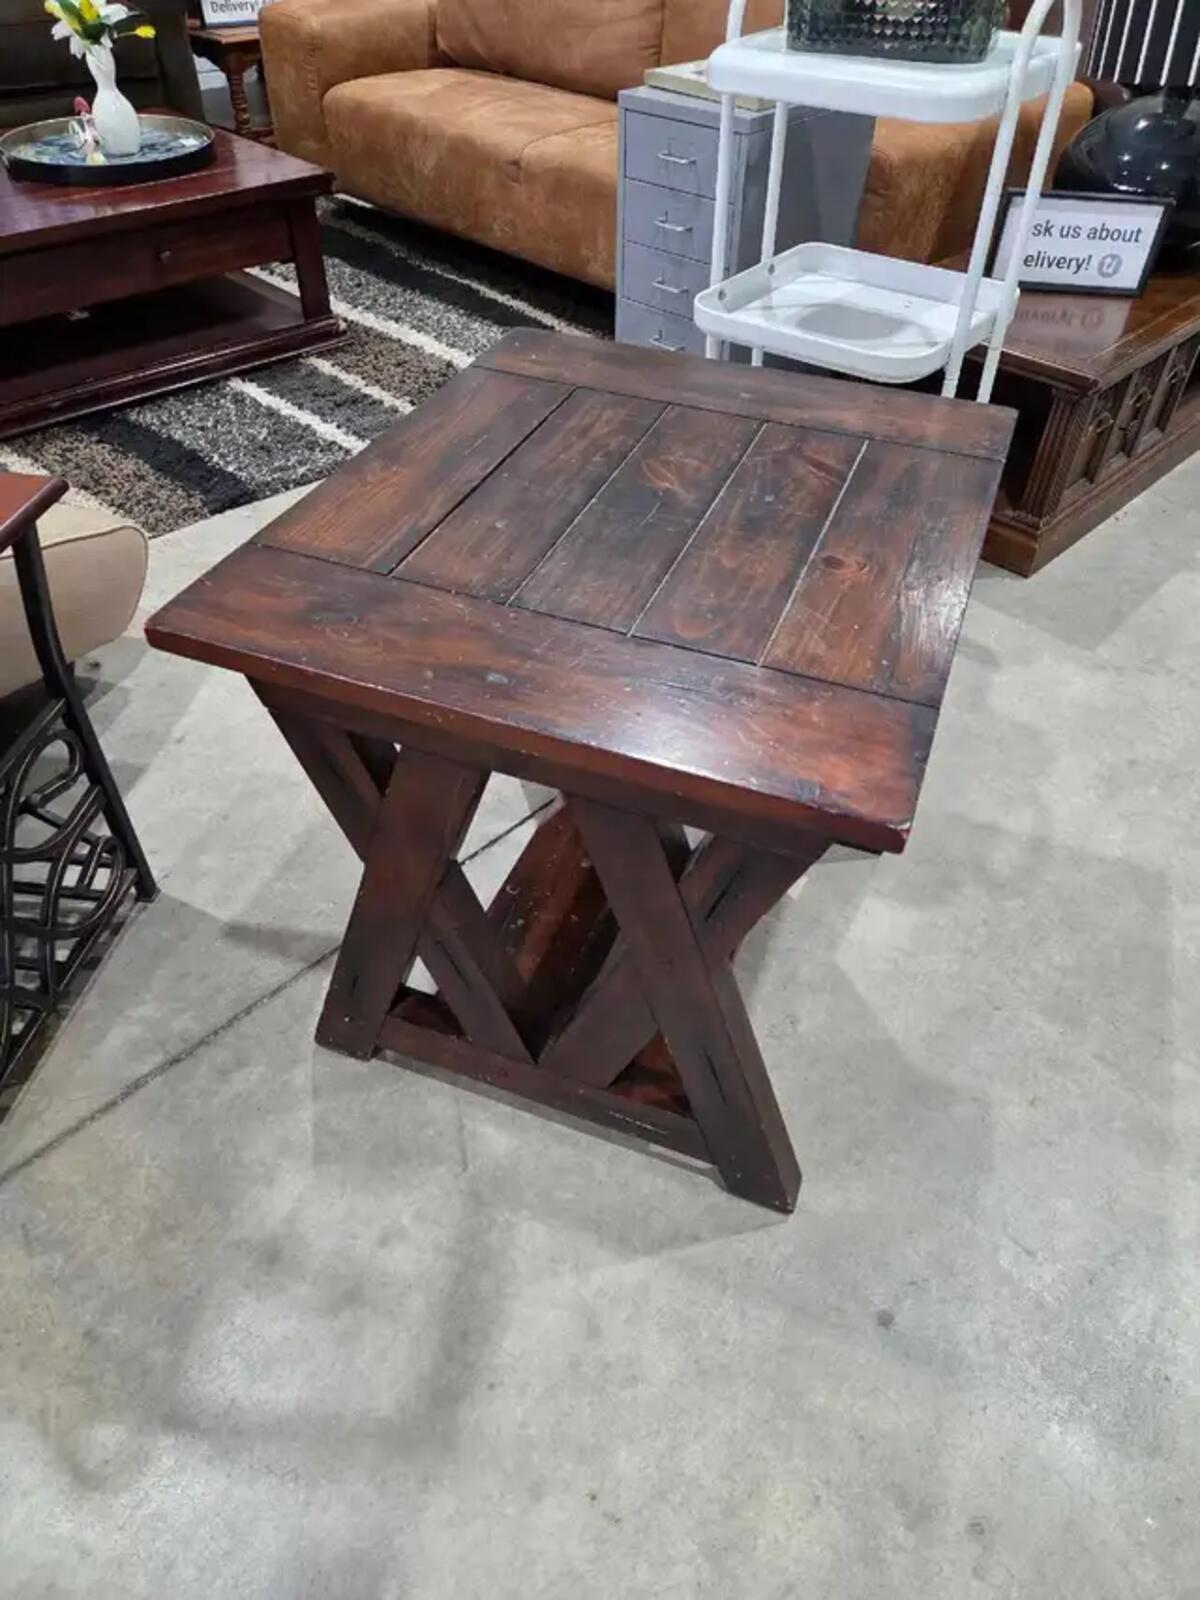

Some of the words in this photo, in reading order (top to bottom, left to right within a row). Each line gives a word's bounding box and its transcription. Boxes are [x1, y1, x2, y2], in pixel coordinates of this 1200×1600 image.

[1031, 220, 1054, 238] sk
[1059, 223, 1082, 239] us
[1086, 222, 1143, 243] about
[1023, 250, 1092, 274] elivery!
